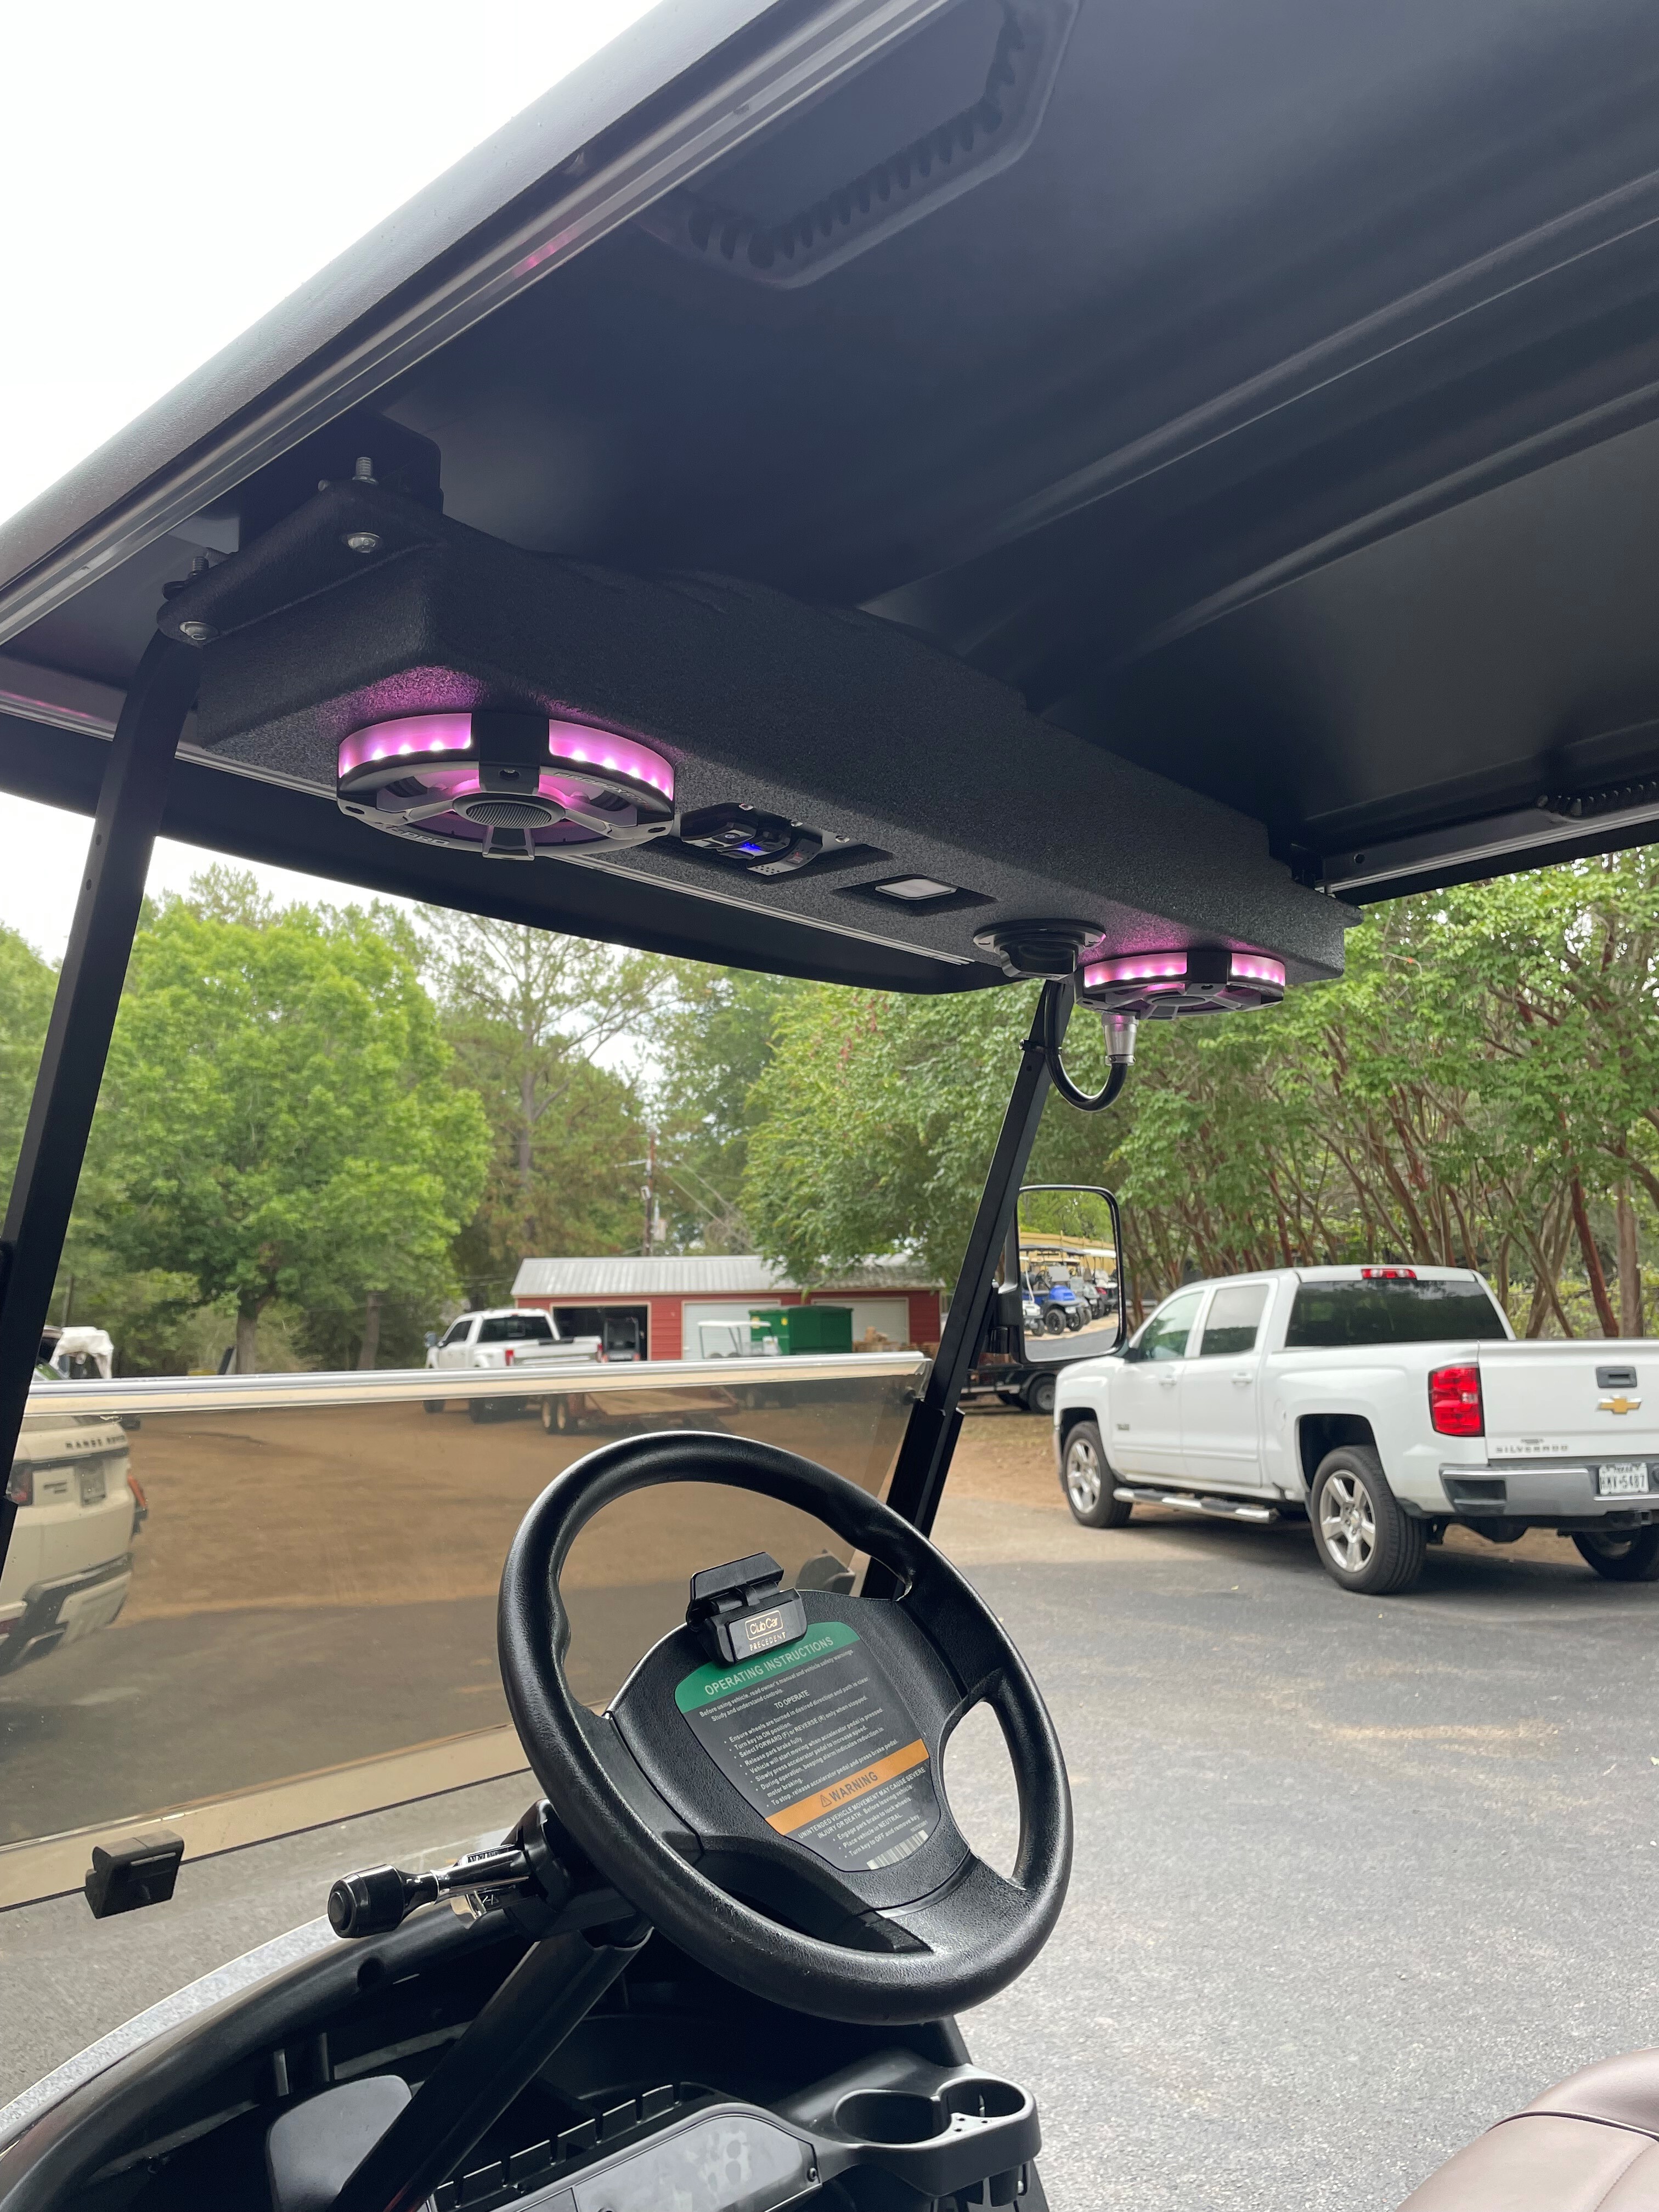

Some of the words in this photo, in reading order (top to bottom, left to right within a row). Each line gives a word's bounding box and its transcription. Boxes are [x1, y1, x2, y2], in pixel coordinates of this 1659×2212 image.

[749, 1632, 786, 1651] PRECEDENT
[705, 1666, 763, 1694] OPERATING
[764, 1637, 833, 1670] INSTRUCTIONS
[699, 1707, 717, 1717] Before
[716, 1701, 732, 1709] using
[749, 1688, 761, 1696] read
[760, 1681, 779, 1691] owner's
[804, 1663, 820, 1673] vehicle
[820, 1657, 834, 1666] safety
[783, 1690, 809, 1705] OPERATE
[711, 1712, 727, 1721] Study
[736, 1696, 763, 1711] understand
[729, 1731, 748, 1742] Ensure
[748, 1724, 765, 1734] wheels
[773, 1712, 790, 1723] turned
[795, 1701, 813, 1713] desired
[813, 1693, 833, 1705] direction
[842, 1684, 853, 1692] path
[739, 1746, 756, 1757] Select
[755, 1735, 782, 1750] FORWARD
[781, 1731, 790, 1739] (F)
[794, 1718, 818, 1731] REVERSE
[835, 1705, 848, 1713] when
[749, 1762, 769, 1773] Vehicle
[778, 1752, 791, 1760] start
[790, 1744, 809, 1755] moving
[821, 1725, 847, 1740] accelerator
[847, 1718, 860, 1729] pedal
[770, 1723, 792, 1735] position.
[744, 1754, 765, 1765] Release
[765, 1748, 777, 1757] park
[776, 1742, 791, 1751] brake
[755, 1771, 773, 1781] Slowly
[772, 1764, 787, 1775] press
[787, 1751, 814, 1767] accelerator
[814, 1743, 827, 1755] pedal
[831, 1733, 852, 1745] increase
[760, 1779, 779, 1790] During
[803, 1757, 823, 1769] beeping
[822, 1751, 836, 1759] alarm
[834, 1741, 857, 1753] indicates
[856, 1730, 879, 1742] reduction
[792, 1784, 810, 1795] release
[810, 1770, 836, 1786] accelerator
[836, 1763, 850, 1774] pedal
[849, 1759, 859, 1767] and
[858, 1753, 872, 1763] press
[870, 1747, 884, 1756] brake
[767, 1787, 782, 1797] motor
[798, 1818, 831, 1838] UNINTENDED
[830, 1807, 853, 1821] VEHICLE
[851, 1792, 879, 1810] MOVEMENT
[878, 1786, 889, 1796] MAY
[889, 1778, 906, 1790] CAUSE
[905, 1767, 925, 1781] SEVERE
[829, 1771, 877, 1801] WARNING
[817, 1825, 836, 1838] INJURY
[862, 1803, 879, 1814] Before
[878, 1794, 896, 1805] leaving
[837, 1827, 856, 1839] Engage
[856, 1821, 867, 1831] park
[865, 1814, 879, 1824] brake
[884, 1805, 895, 1813] lock
[843, 1838, 857, 1848] Place
[857, 1829, 874, 1840] vehicle
[848, 1847, 861, 1856] Turn
[874, 1832, 884, 1842] OFF
[885, 1827, 894, 1836] and
[894, 1819, 911, 1831] remove
